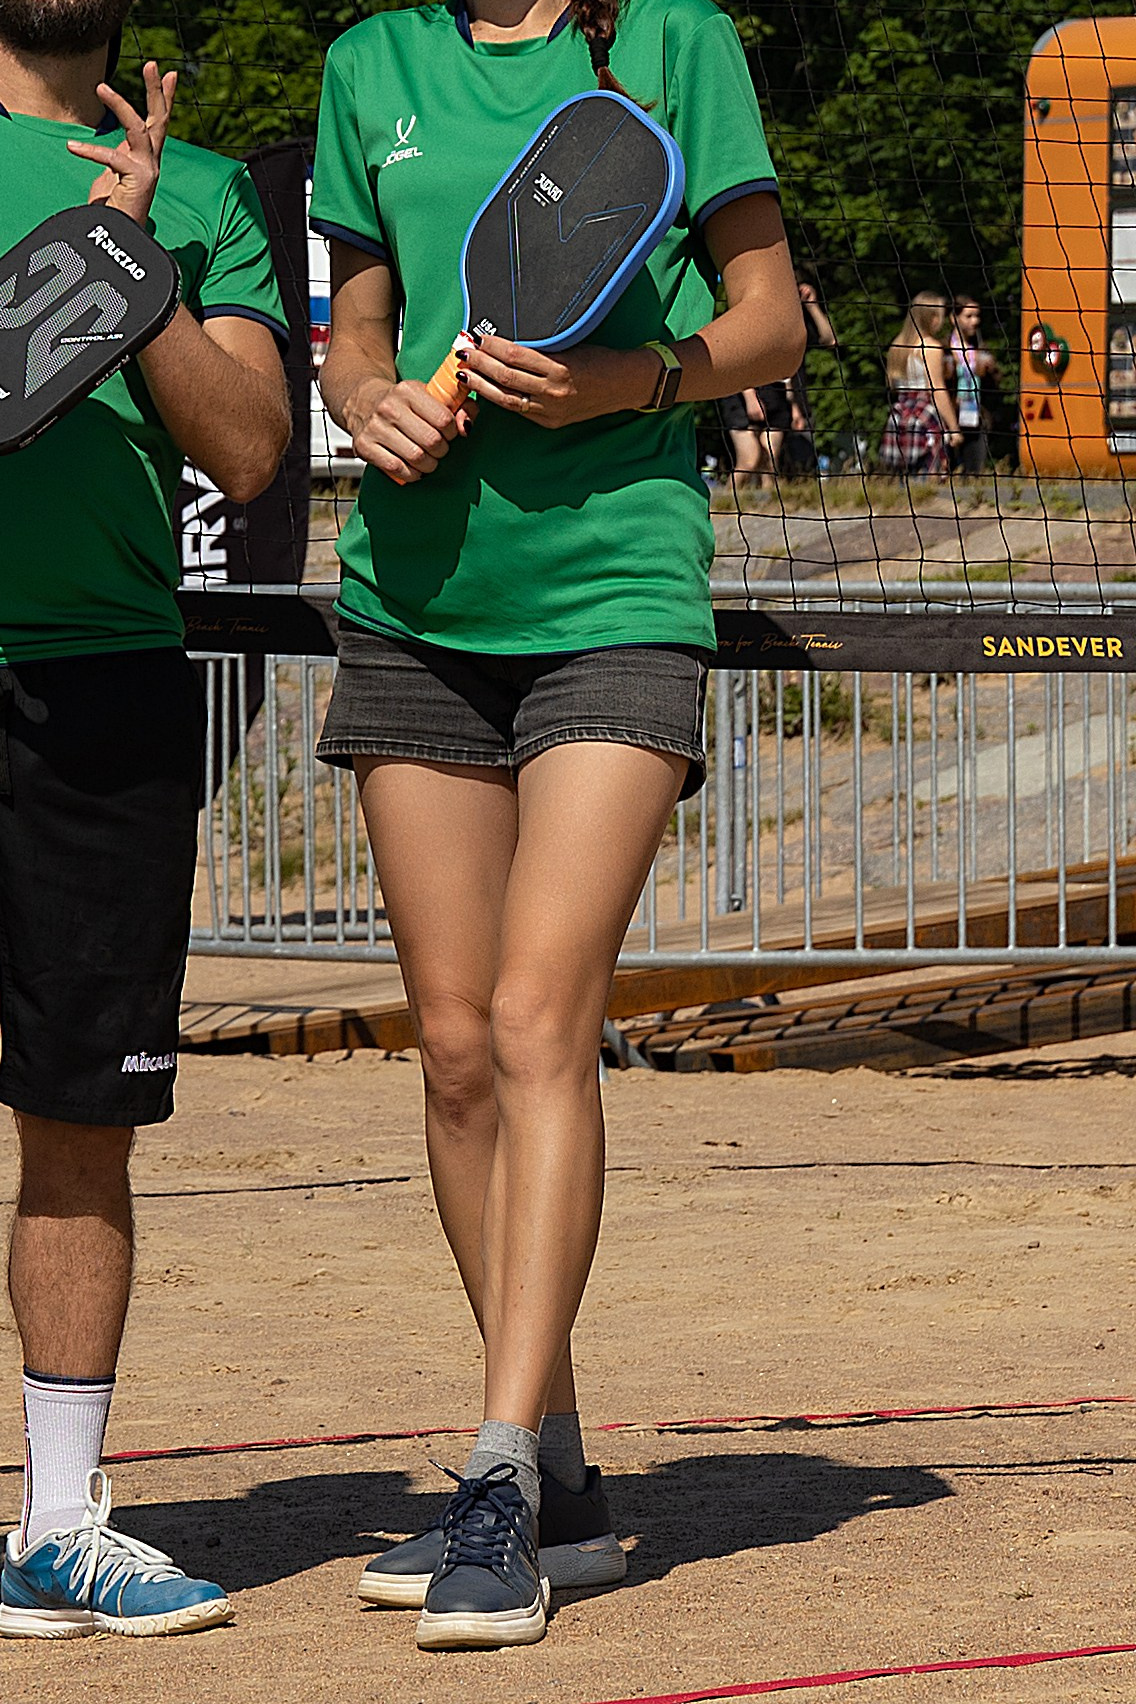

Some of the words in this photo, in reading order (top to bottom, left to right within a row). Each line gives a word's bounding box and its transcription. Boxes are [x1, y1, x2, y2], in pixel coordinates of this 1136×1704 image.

[101, 237, 146, 281] JUCIAO
[227, 617, 270, 635] Tennis
[735, 634, 753, 653] for
[760, 633, 800, 652] Beach
[800, 633, 843, 652] Tennis
[982, 635, 1124, 658] SANDEVER
